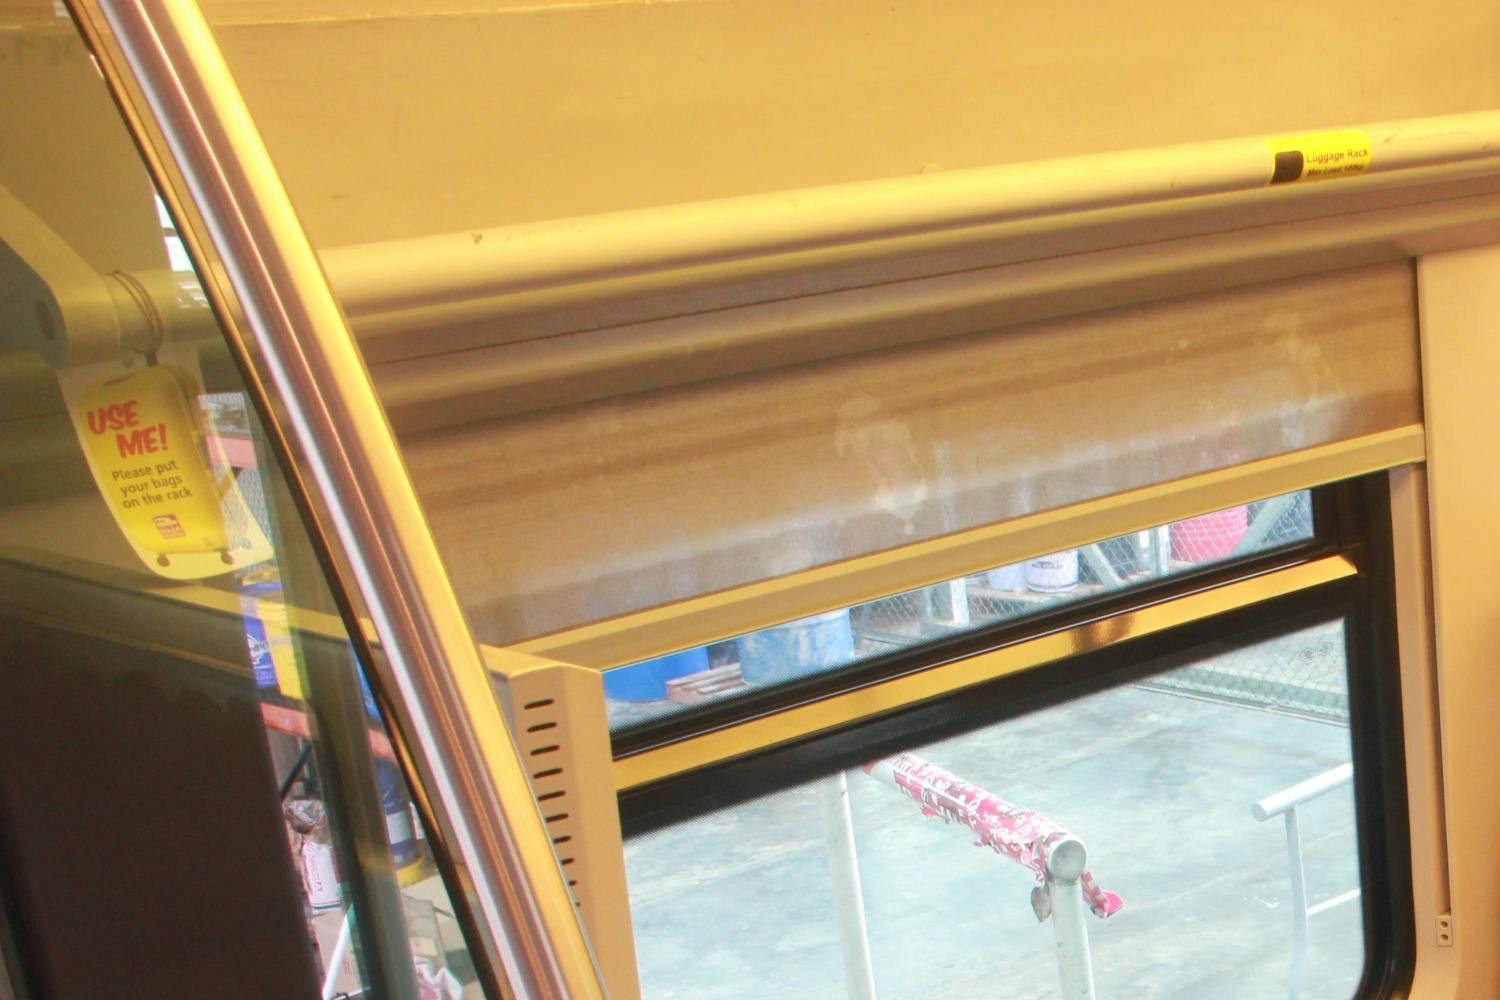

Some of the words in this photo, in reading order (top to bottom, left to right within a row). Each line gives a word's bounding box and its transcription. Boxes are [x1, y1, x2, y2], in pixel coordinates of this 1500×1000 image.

[1306, 152, 1345, 164] Luggage
[1346, 147, 1368, 159] Rack
[87, 400, 139, 434] USE
[116, 423, 169, 459] ME!
[112, 464, 152, 482] Please
[156, 460, 178, 476] put
[120, 478, 149, 498] your
[153, 473, 183, 491] bags
[123, 496, 140, 509] on
[142, 490, 163, 505] the
[167, 485, 192, 501] rack
